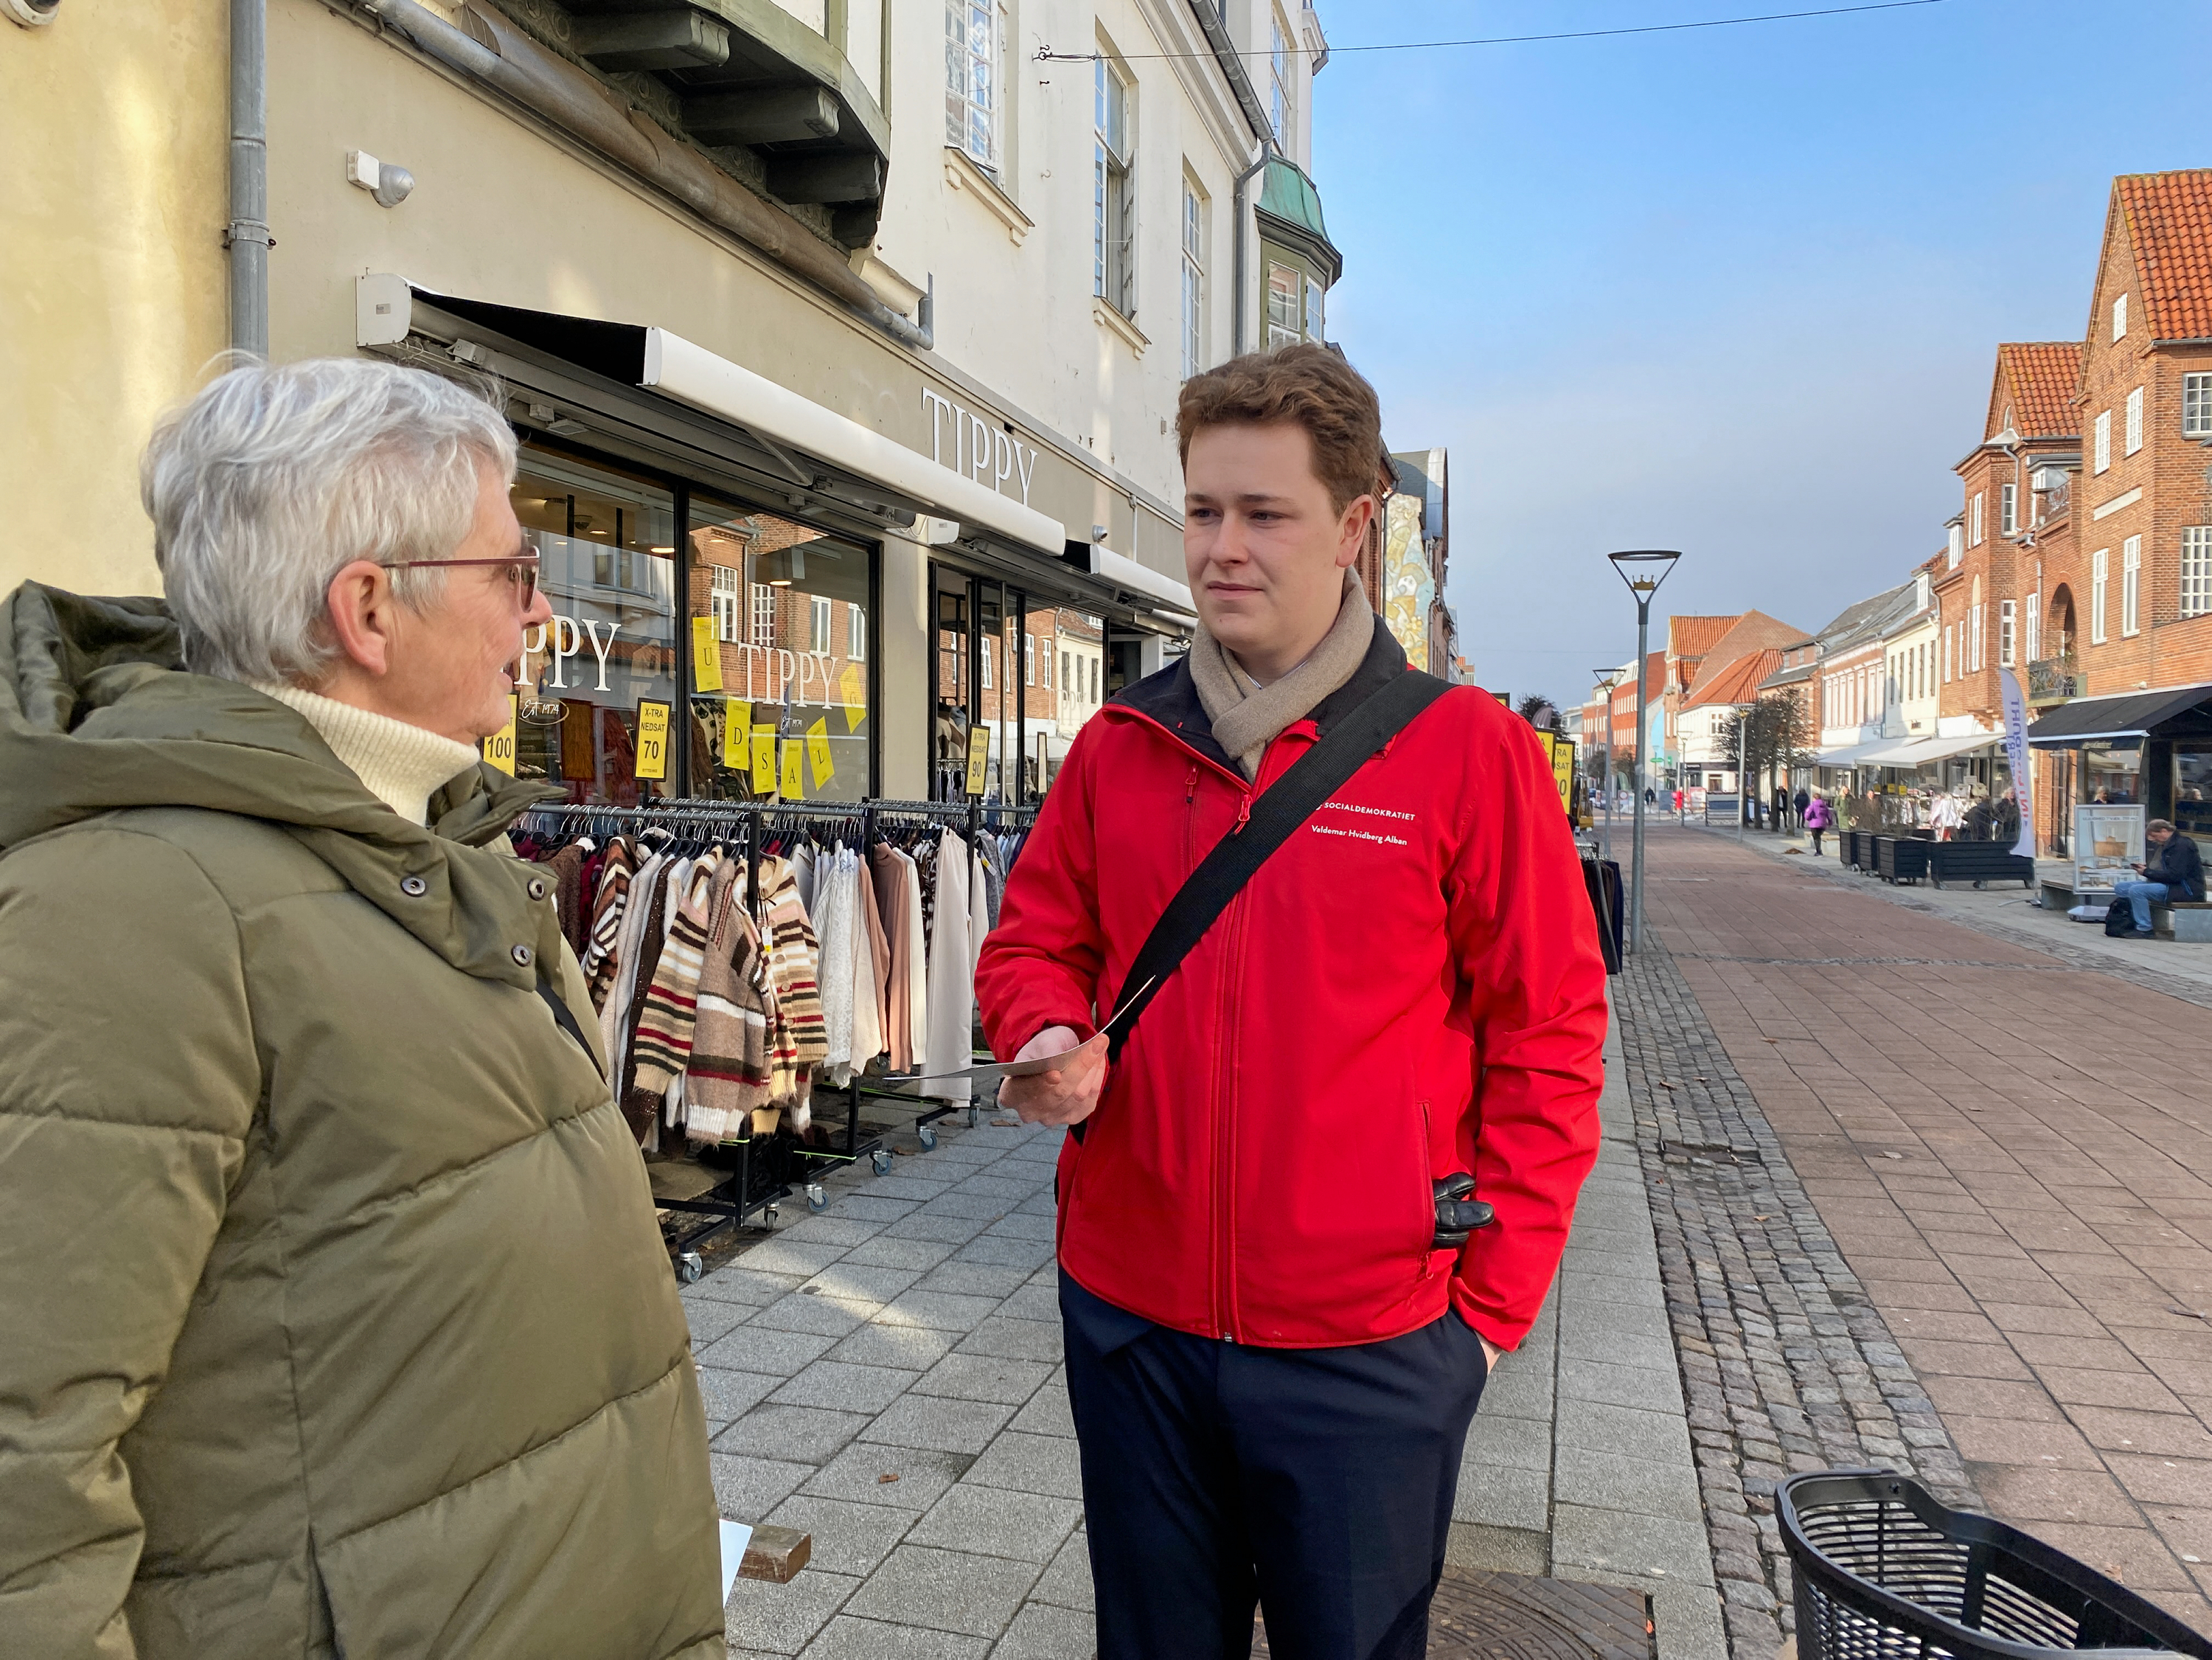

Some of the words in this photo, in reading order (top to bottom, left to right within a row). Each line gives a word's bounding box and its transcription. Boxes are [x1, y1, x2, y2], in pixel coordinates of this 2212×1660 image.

[922, 386, 1037, 507] TIPPY
[514, 614, 622, 692] PPY
[703, 647, 712, 666] U
[737, 642, 838, 709] TIPPY
[541, 703, 560, 715] 1974
[644, 708, 664, 718] X-TRA
[640, 722, 665, 733] NEDSAT
[733, 726, 742, 745] D
[974, 732, 986, 742] X-TRA
[487, 737, 512, 759] 100
[644, 740, 659, 760] 70
[817, 749, 825, 765] L
[971, 745, 987, 754] NEDSAT
[762, 752, 768, 770] S
[972, 760, 981, 778] 90
[1555, 762, 1570, 771] SAT
[788, 767, 796, 784] A
[1324, 802, 1416, 821] SOCIALDEMOKRATIET
[1311, 824, 1347, 836] Valdemar
[1349, 830, 1383, 844] Hvidberg
[1384, 835, 1408, 846] Alban
